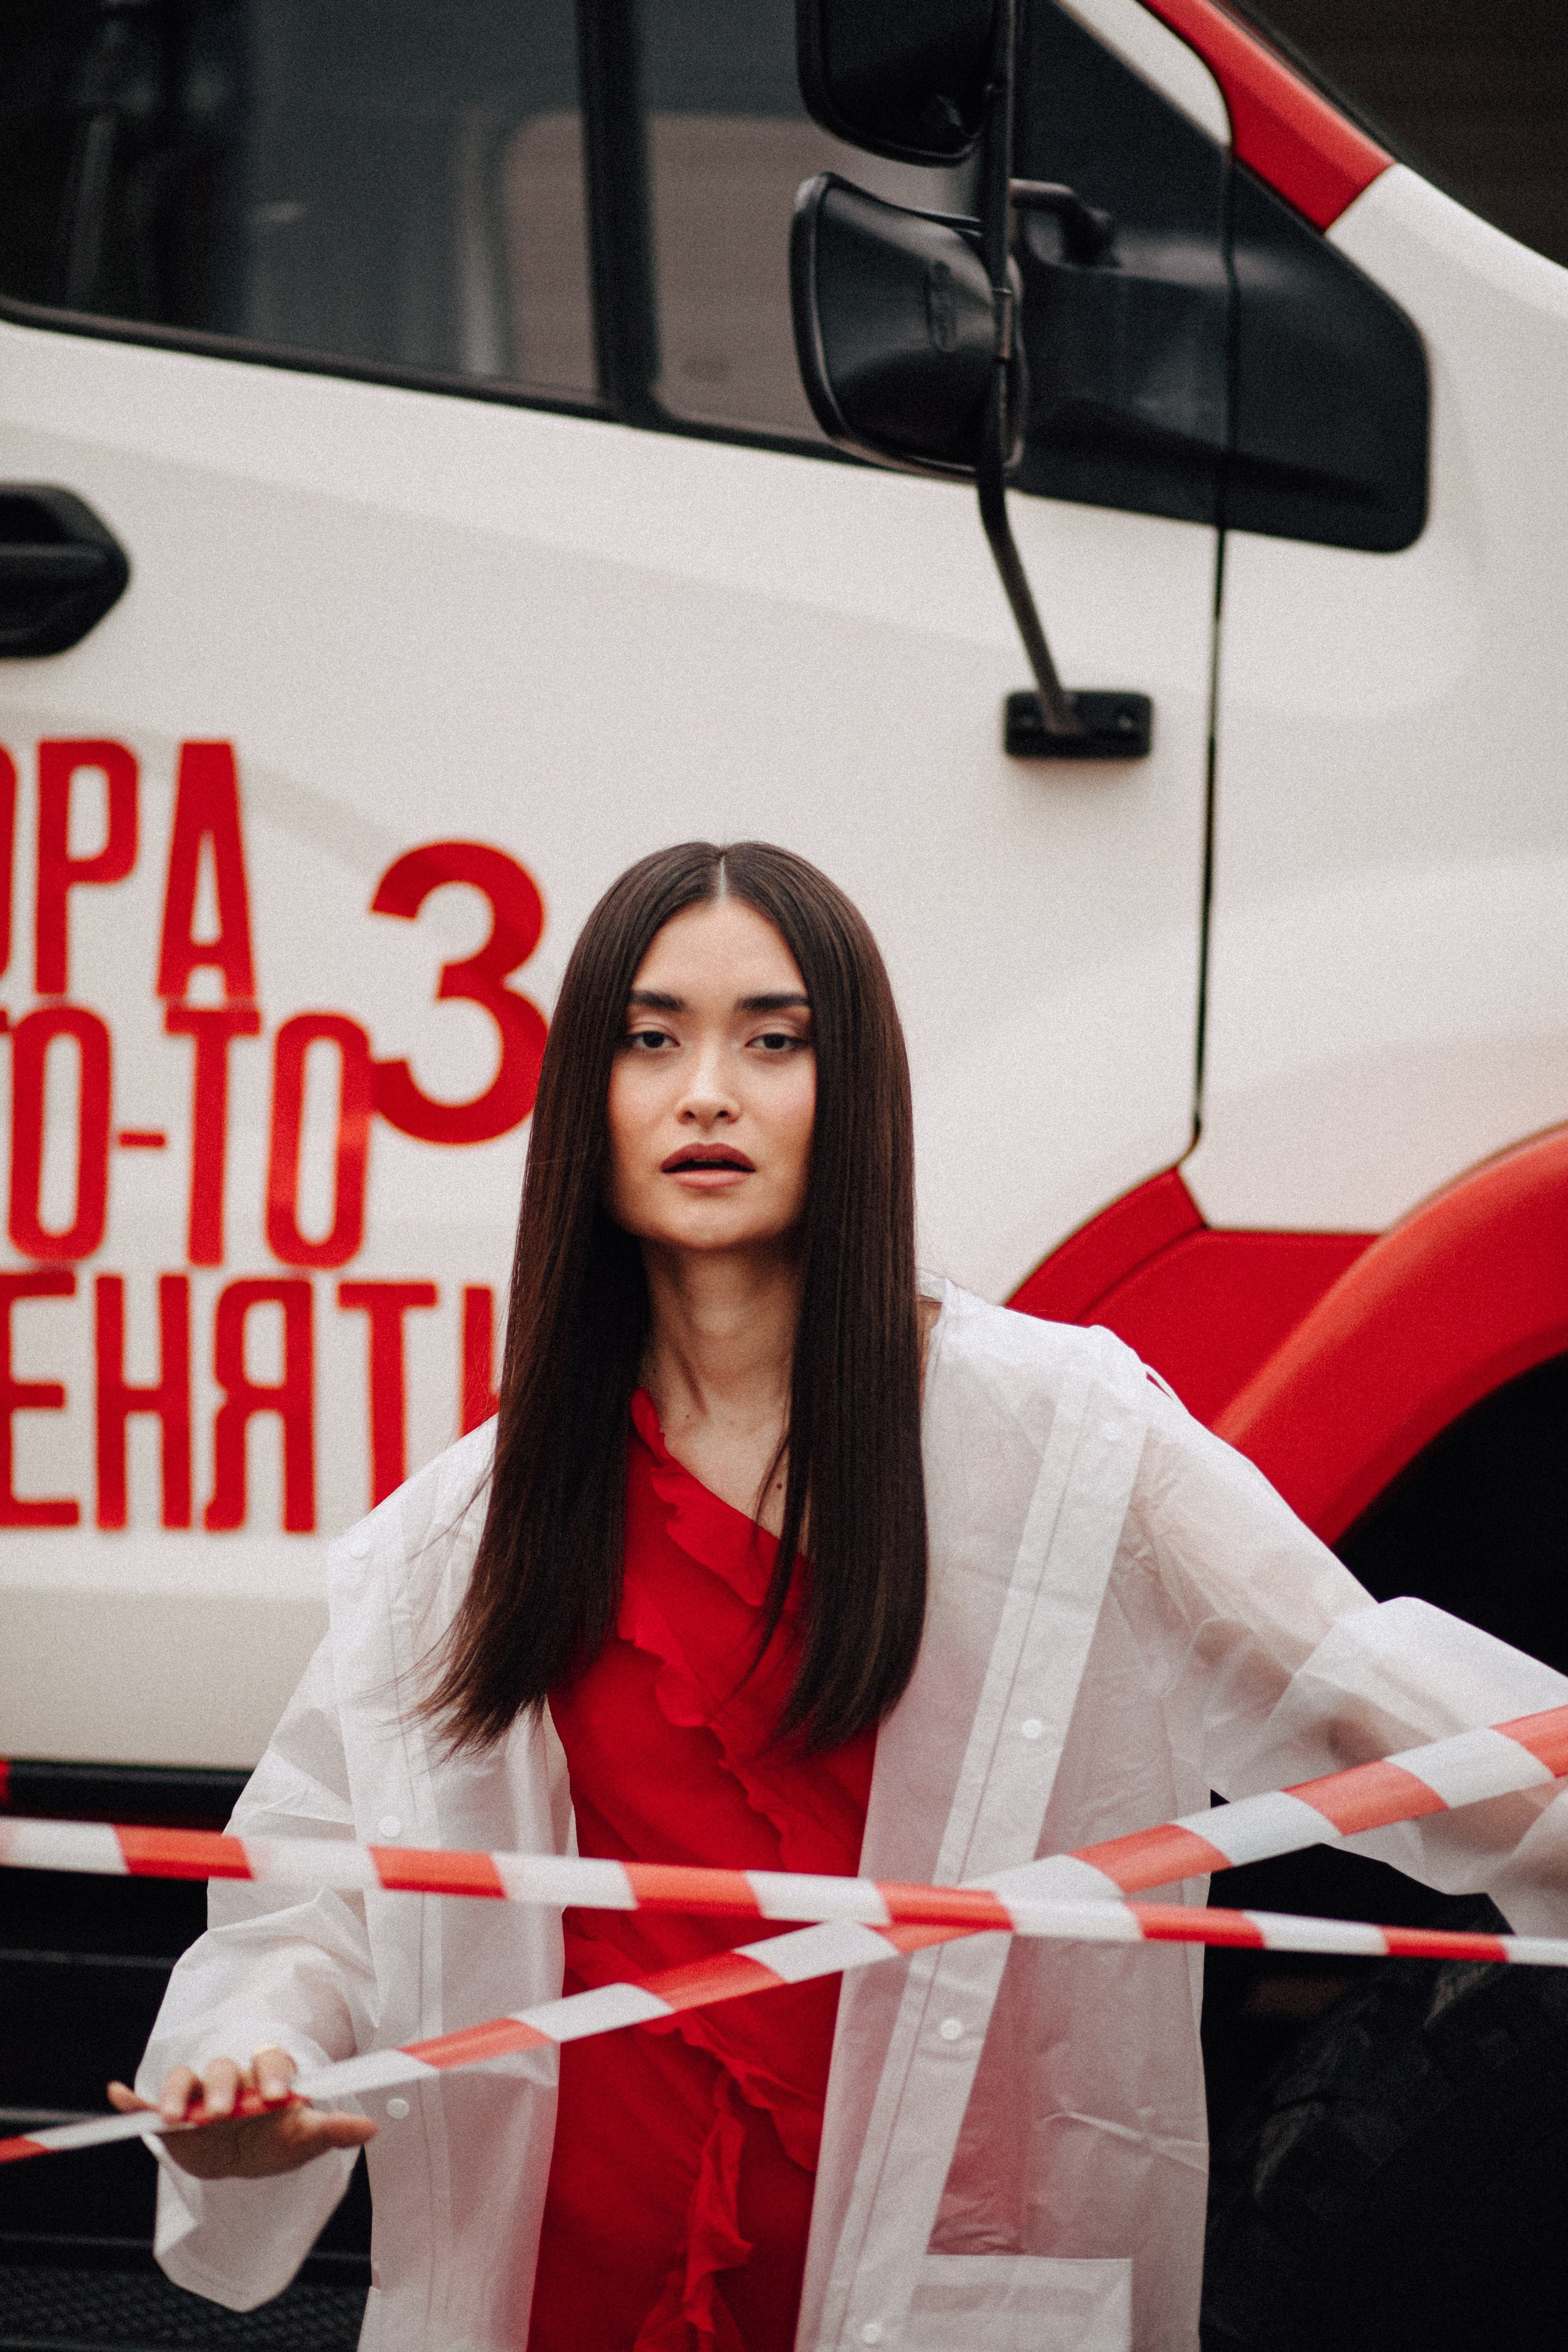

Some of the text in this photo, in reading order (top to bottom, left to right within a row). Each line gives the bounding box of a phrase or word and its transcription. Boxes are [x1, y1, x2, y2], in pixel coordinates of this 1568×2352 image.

[0, 737, 256, 996] РА
[370, 839, 550, 1147] 3
[0, 1005, 370, 1270] О-ТО
